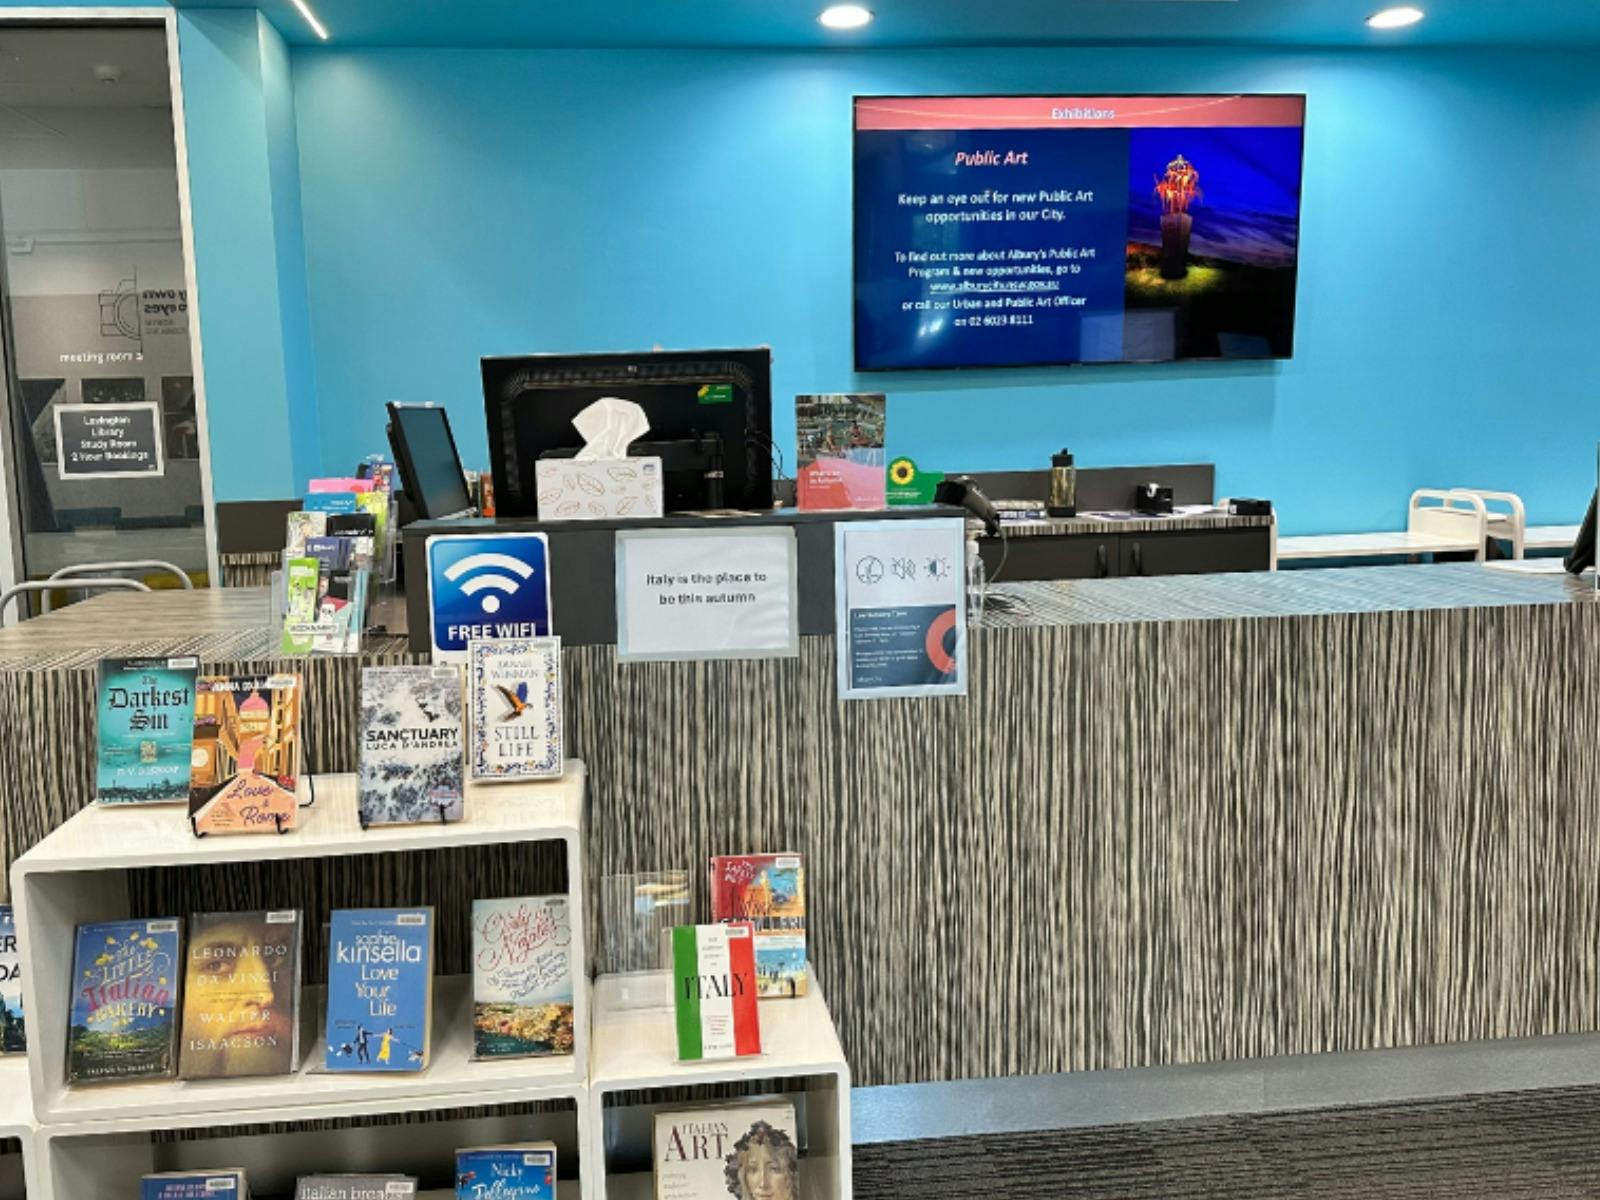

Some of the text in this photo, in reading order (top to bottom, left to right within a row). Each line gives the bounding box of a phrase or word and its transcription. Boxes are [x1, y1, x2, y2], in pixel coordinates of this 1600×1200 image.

[1051, 107, 1115, 120] Exhibitions
[955, 150, 1029, 166] Public Art
[898, 190, 1093, 206] Keep an eye out for new Public Art
[925, 209, 1003, 224] opportunities
[1006, 209, 1015, 221] in
[1019, 210, 1038, 221] our
[895, 248, 1096, 263] To find out more about Albury's Public Art
[908, 267, 950, 278] Program
[953, 266, 961, 276] &
[963, 267, 983, 276] new
[1056, 266, 1067, 276] go
[1069, 264, 1081, 274] to
[902, 296, 1087, 311] or call our Urban and Public Art Officer
[954, 318, 966, 327] on
[968, 317, 982, 326] 02
[60, 352, 104, 364] meeting
[106, 353, 133, 362] room
[91, 428, 124, 438] Library
[81, 439, 137, 450] Study Room
[646, 572, 767, 586] Italy is the place to
[659, 593, 756, 605] be this autumn
[448, 623, 536, 640] FREE WIFI
[108, 687, 190, 710] Darkest
[129, 709, 168, 731] Sin
[366, 728, 458, 742] SANCTUARY
[495, 726, 540, 741] STILL
[366, 741, 458, 750] LUCA D'ANDREA
[498, 743, 534, 757] LIFE
[228, 779, 273, 800] Love
[355, 930, 398, 946] sophie
[192, 945, 288, 960] LEONARDO
[336, 941, 422, 964] kinsella
[197, 973, 278, 987] DA VINCI
[361, 964, 399, 981] Love
[355, 981, 391, 1000] Your
[685, 972, 747, 1000] ITALY
[82, 976, 169, 1012] Italian
[369, 999, 397, 1016] Life
[200, 1010, 271, 1024] WALTER
[190, 1036, 278, 1050] ISAACSON
[682, 1122, 729, 1135] ITALIAN
[664, 1125, 729, 1162] ART
[301, 1184, 346, 1200] italian
